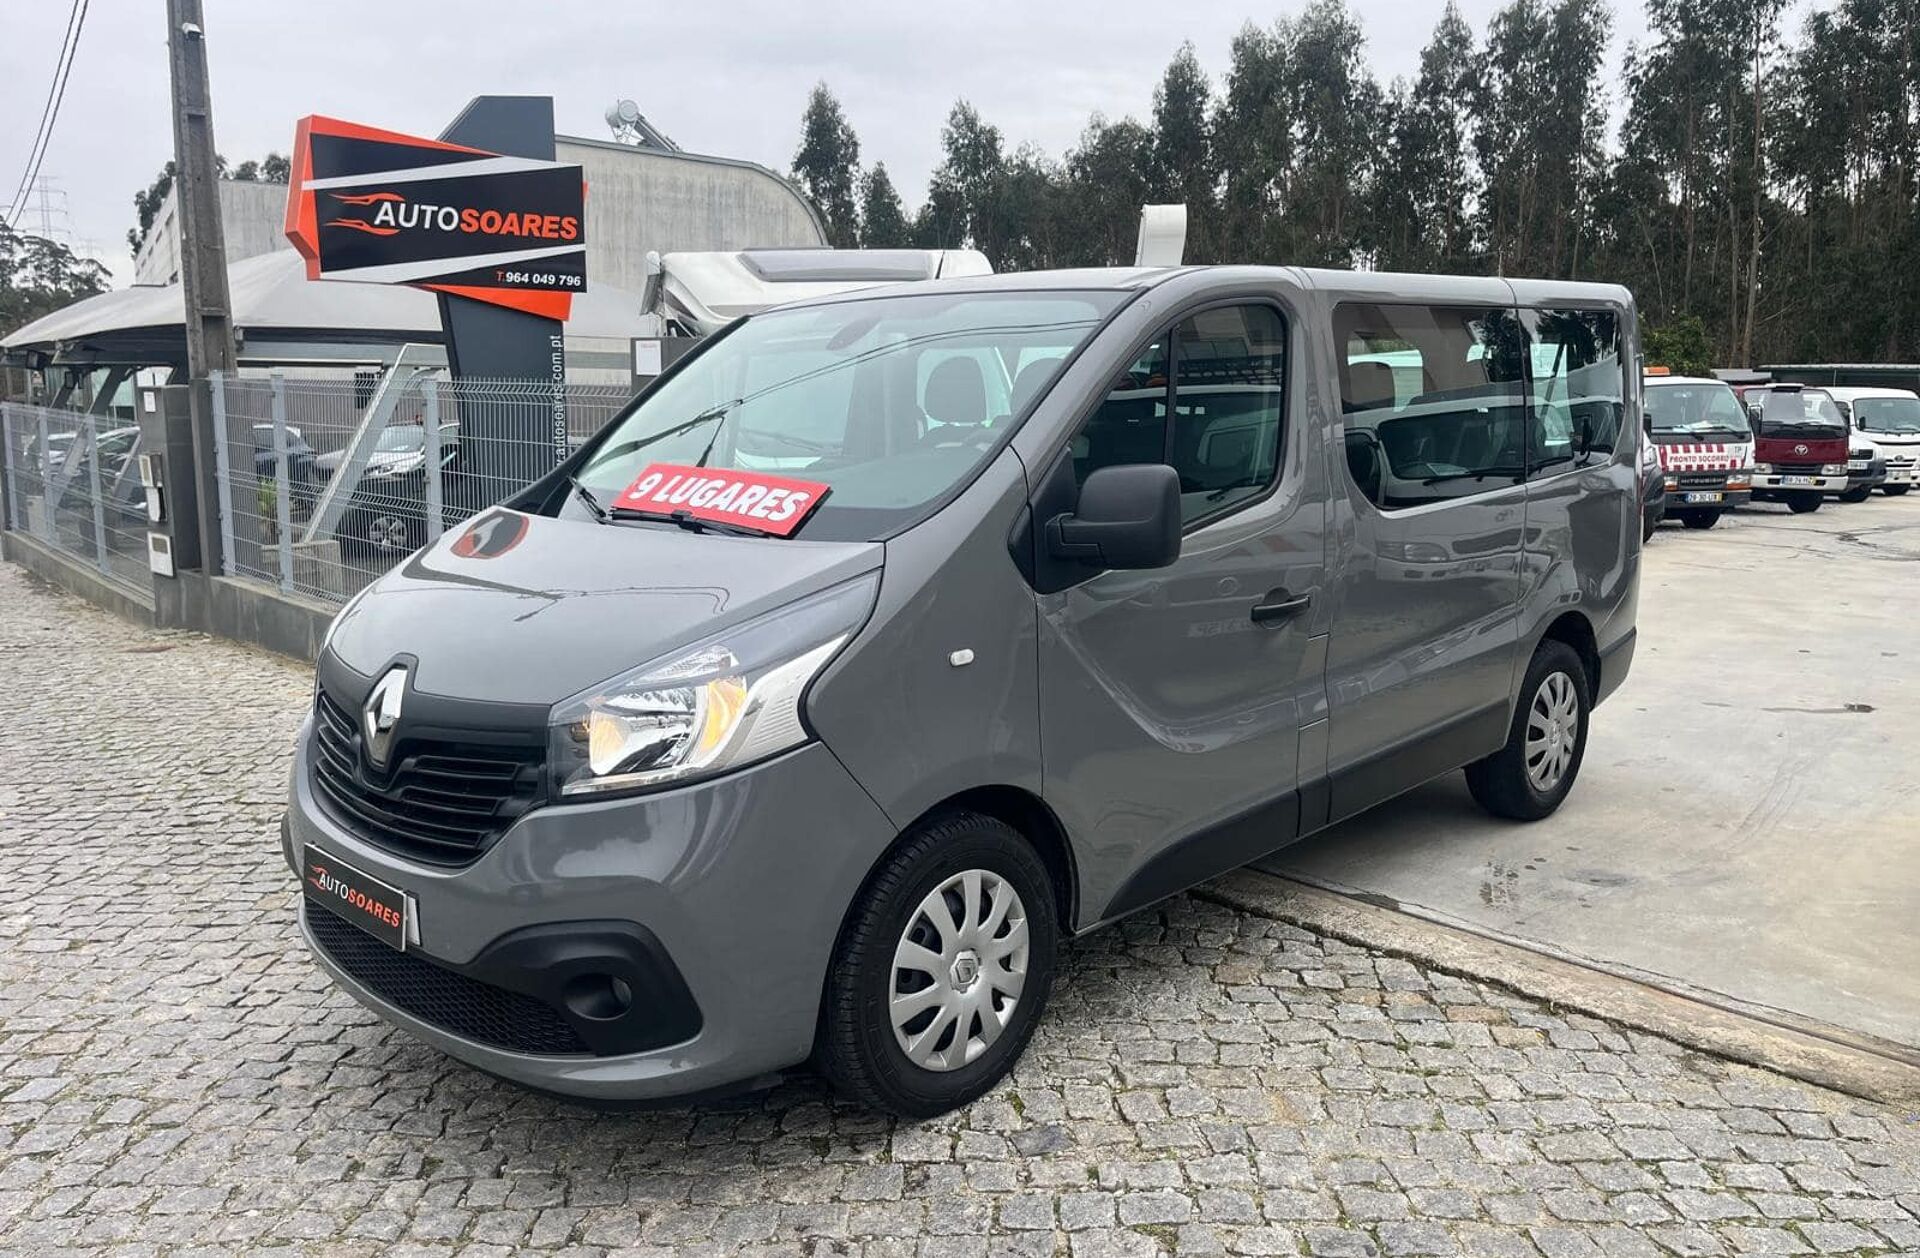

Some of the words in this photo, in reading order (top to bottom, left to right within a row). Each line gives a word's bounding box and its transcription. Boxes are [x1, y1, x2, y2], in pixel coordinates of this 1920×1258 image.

[374, 202, 578, 240] AUTOSOARES
[532, 273, 556, 285] 049
[559, 275, 581, 286] 796
[1669, 455, 1697, 463] PRONTO
[1699, 455, 1729, 463] SOCORRO
[629, 473, 663, 500] 9
[651, 475, 810, 521] LUGARES
[319, 872, 400, 927] AUTOSOARES
